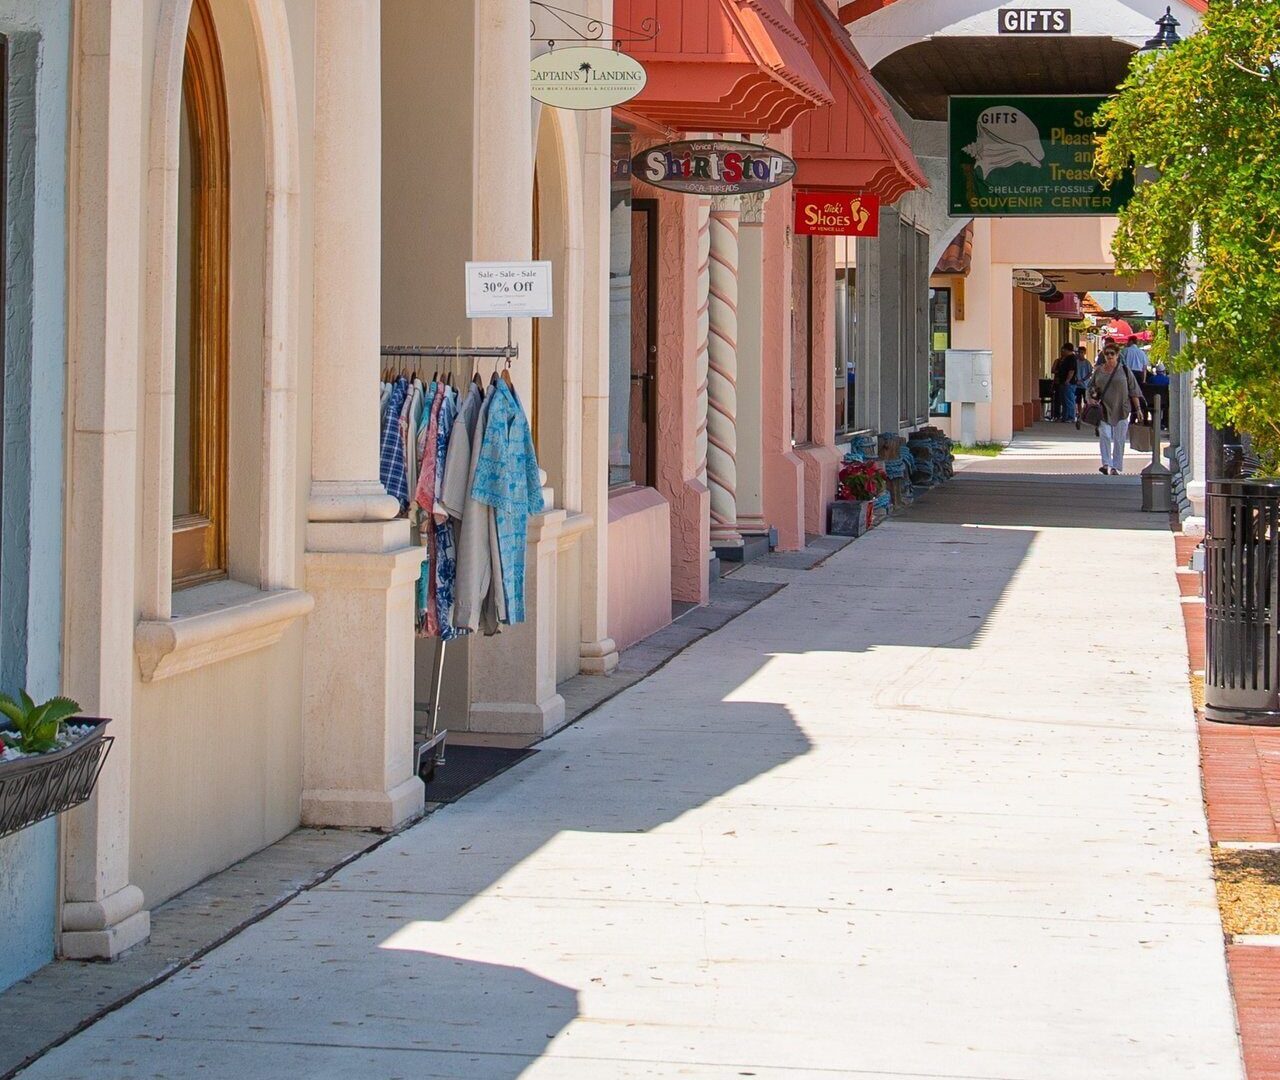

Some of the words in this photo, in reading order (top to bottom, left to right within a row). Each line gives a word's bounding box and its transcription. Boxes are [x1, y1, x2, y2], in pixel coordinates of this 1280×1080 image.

[1003, 9, 1065, 31] GIFTS
[592, 69, 642, 81] LANDING
[980, 112, 1018, 125] GIFTS
[1073, 109, 1092, 128] Se
[690, 143, 712, 151] Venice
[708, 184, 740, 193] THREADS
[823, 202, 844, 214] Dick's
[970, 196, 1043, 208] SOUVENIR
[1051, 196, 1112, 208] CENTER
[804, 204, 851, 226] SHOES
[499, 270, 515, 278] Sale
[482, 281, 510, 293] 30%
[513, 281, 534, 292] Off
